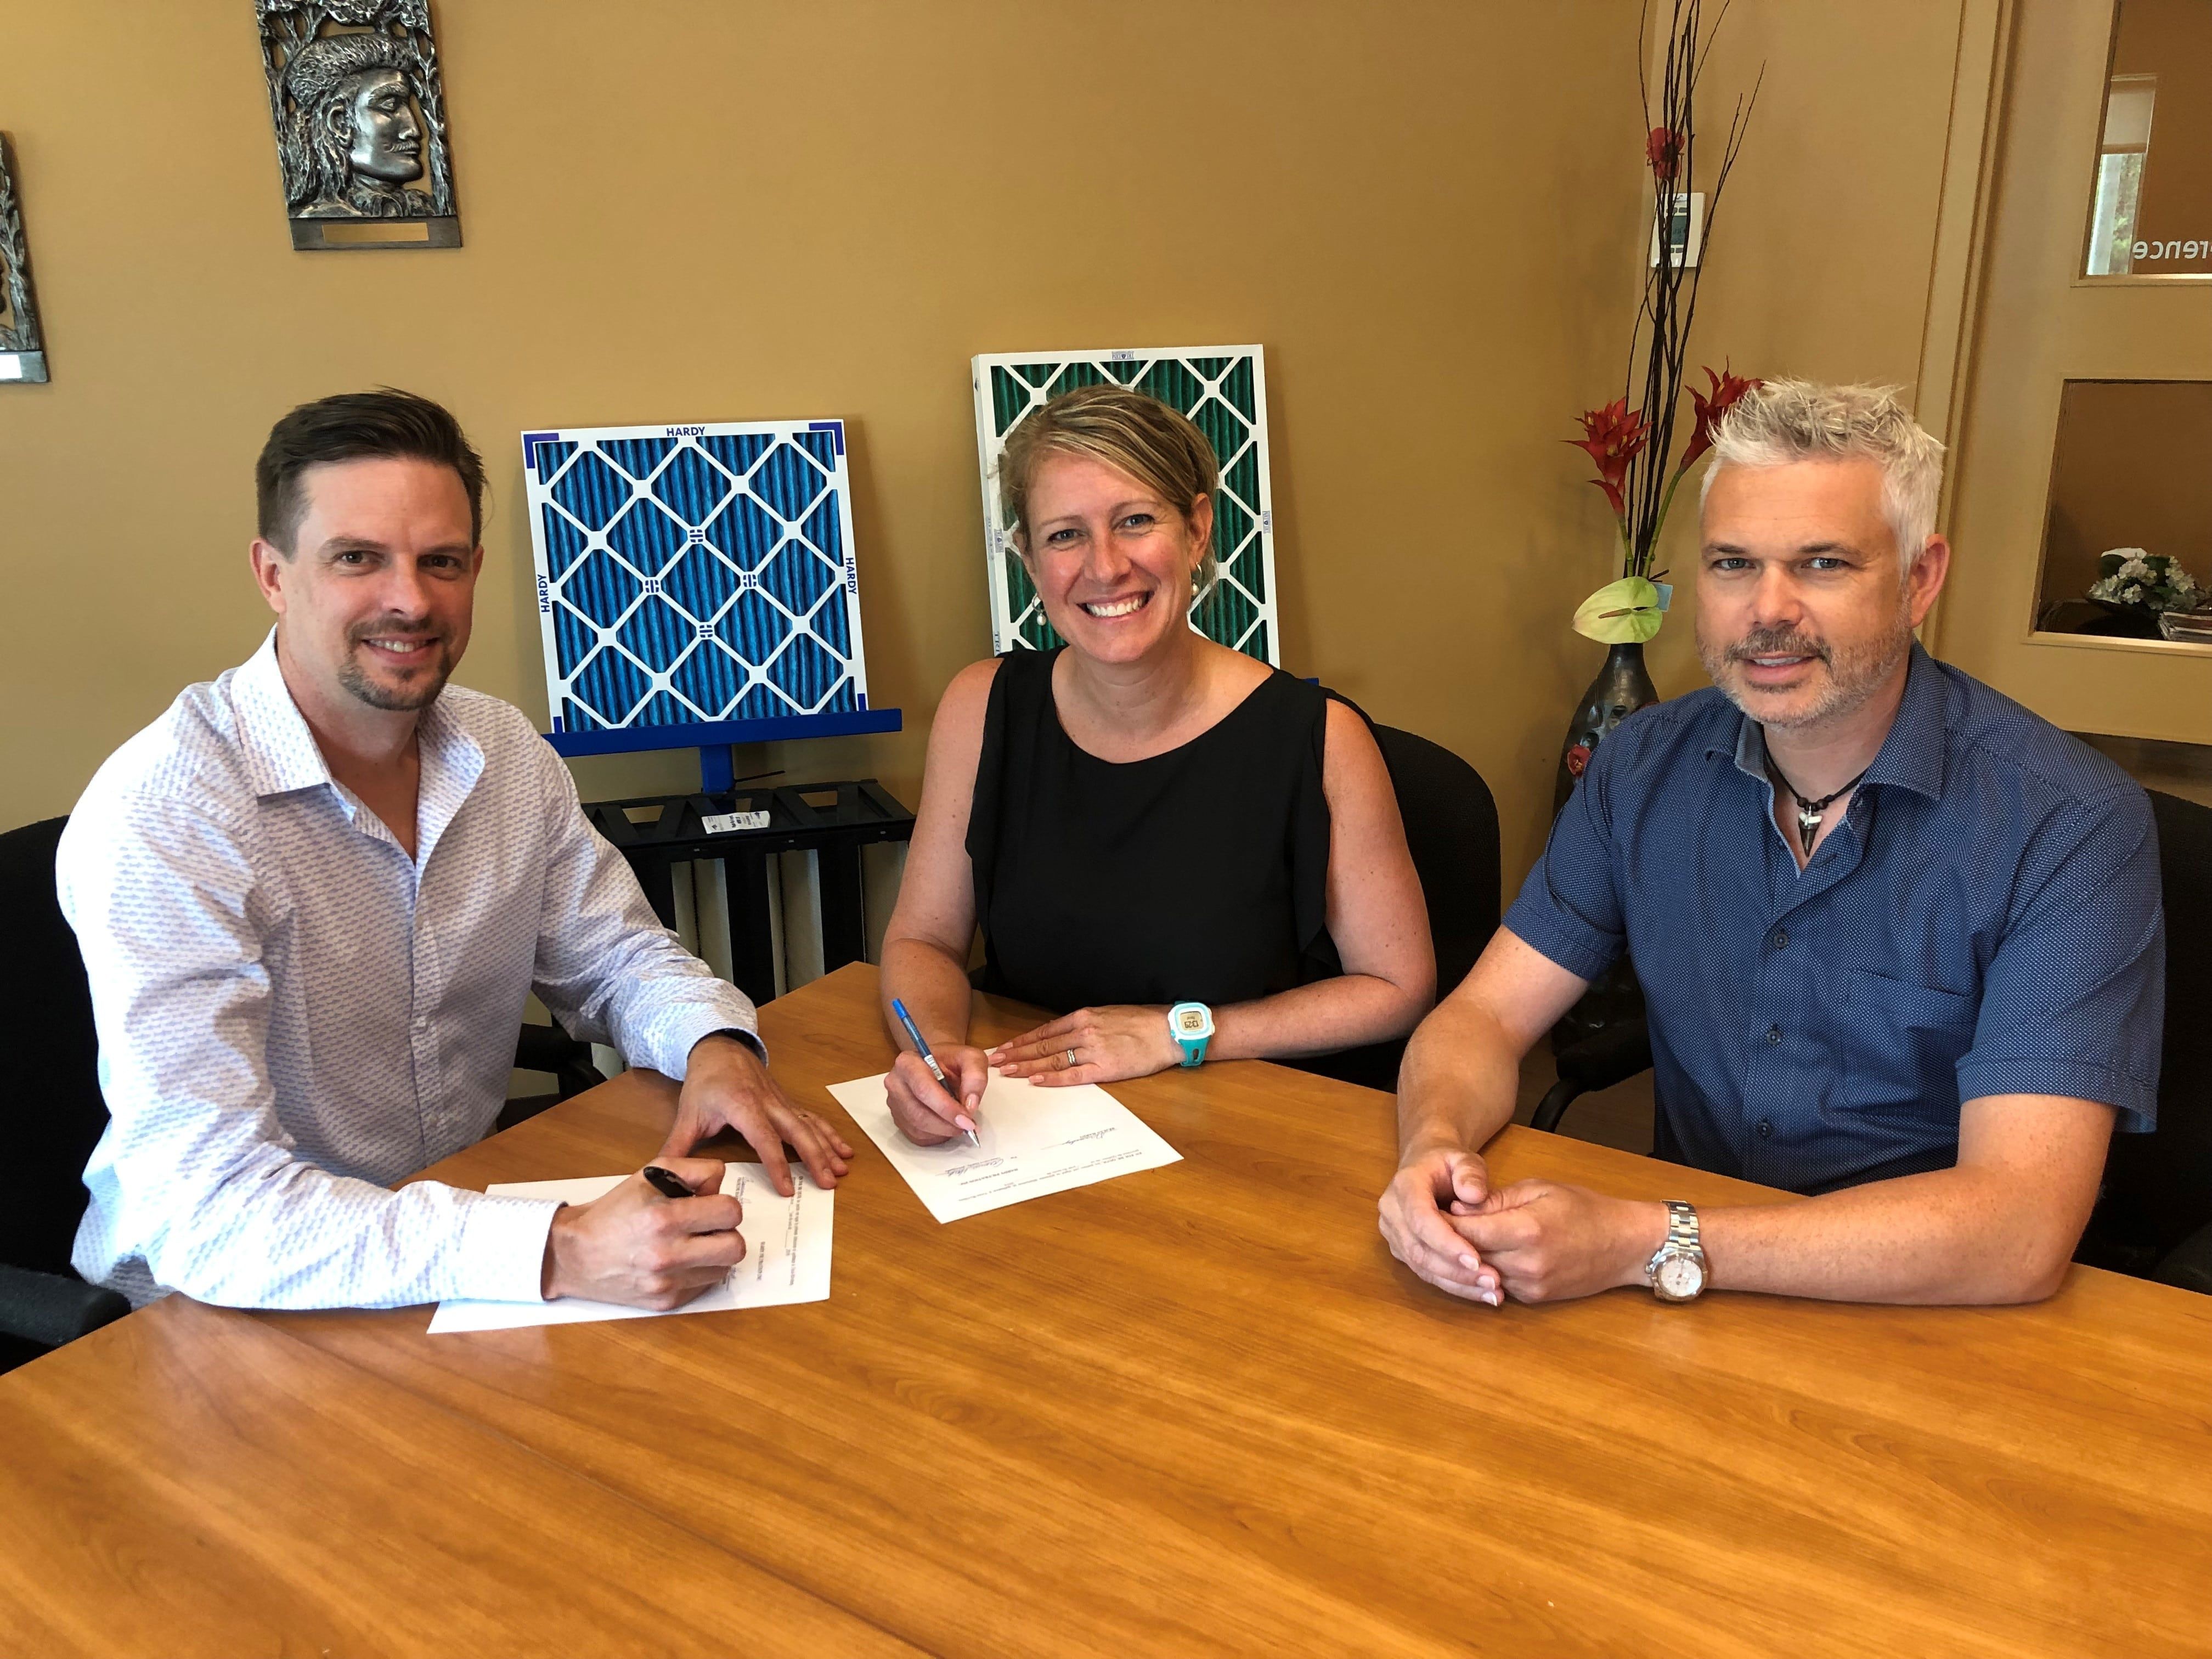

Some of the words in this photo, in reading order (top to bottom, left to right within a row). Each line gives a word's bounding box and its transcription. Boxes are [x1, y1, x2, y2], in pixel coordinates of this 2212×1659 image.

[666, 426, 706, 437] HARDY
[537, 574, 550, 613] HARDY
[845, 557, 857, 595] HARDY
